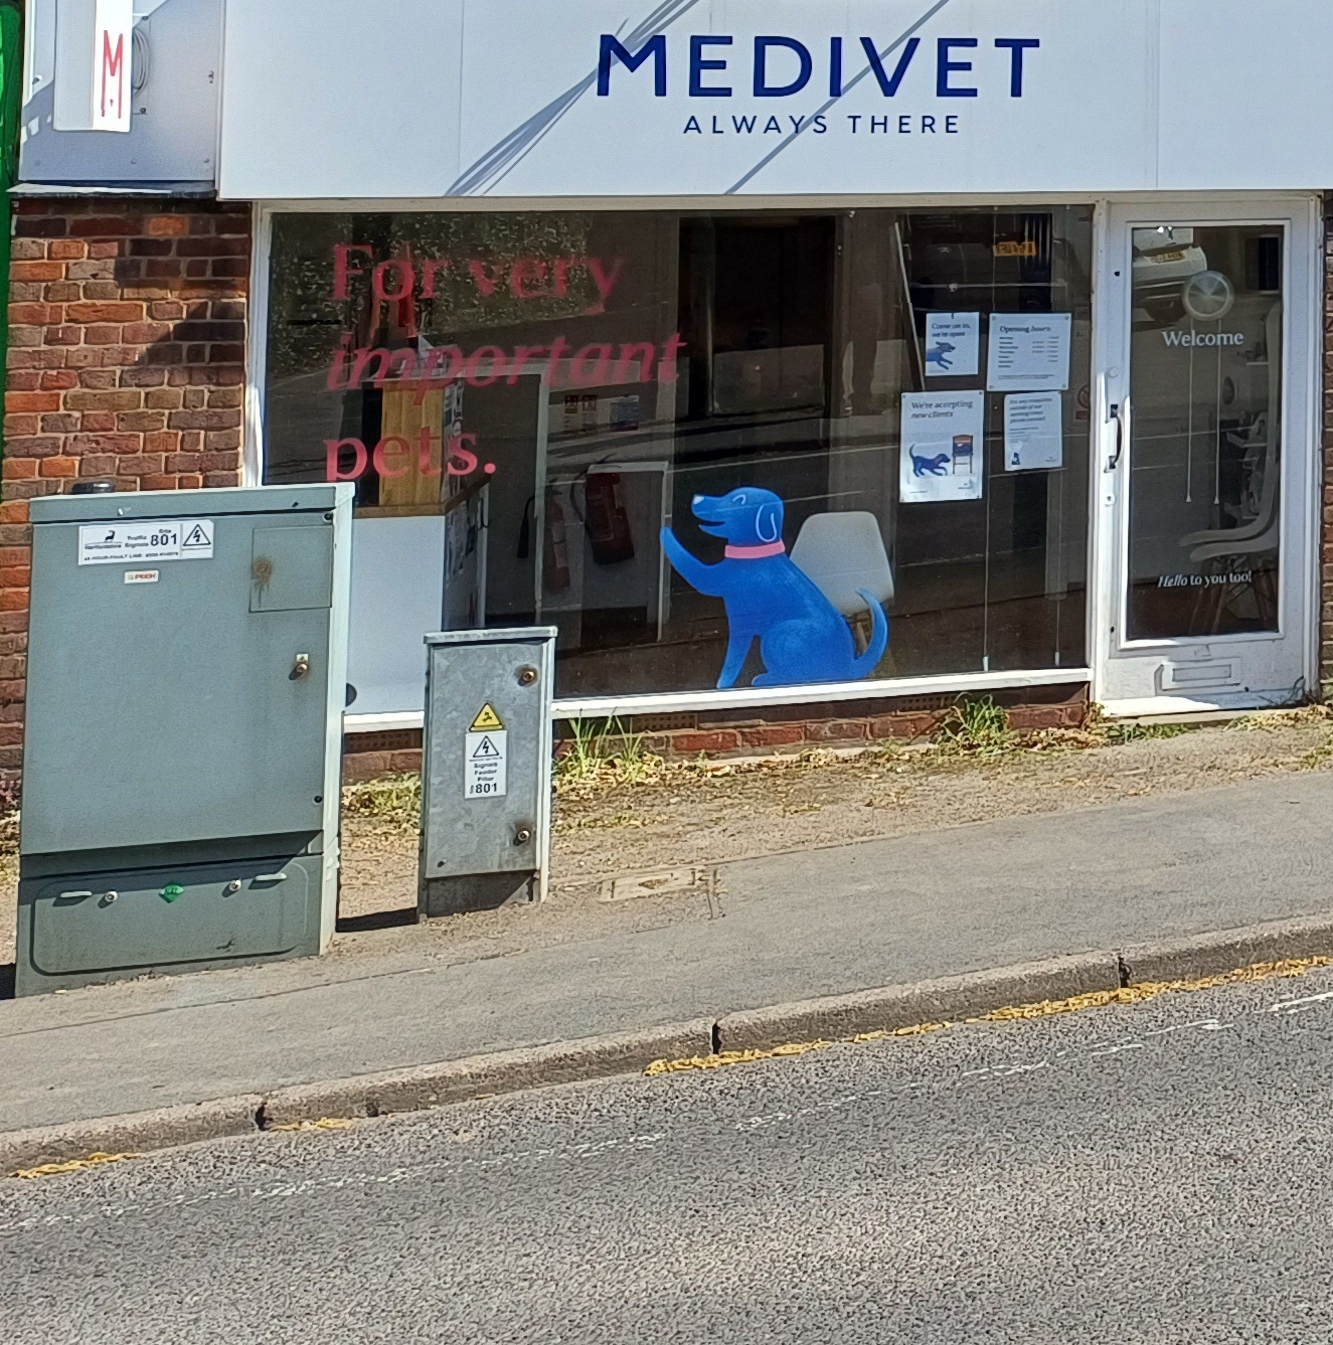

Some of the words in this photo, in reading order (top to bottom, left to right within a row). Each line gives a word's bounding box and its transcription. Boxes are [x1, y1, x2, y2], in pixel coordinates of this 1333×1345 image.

[101, 30, 124, 119] M
[597, 34, 1040, 98] MEDIVET
[683, 115, 828, 134] ALWAYS
[848, 115, 959, 134] THERE
[333, 243, 448, 301] For
[469, 257, 622, 316] very
[1161, 329, 1244, 347] Welcome
[326, 332, 687, 406] important
[324, 426, 496, 482] pets.
[151, 534, 177, 546] 801
[1158, 574, 1188, 588] Hello
[1190, 575, 1202, 586] to
[1204, 574, 1226, 588] you
[1229, 570, 1252, 583] too!
[476, 783, 497, 794] 801
